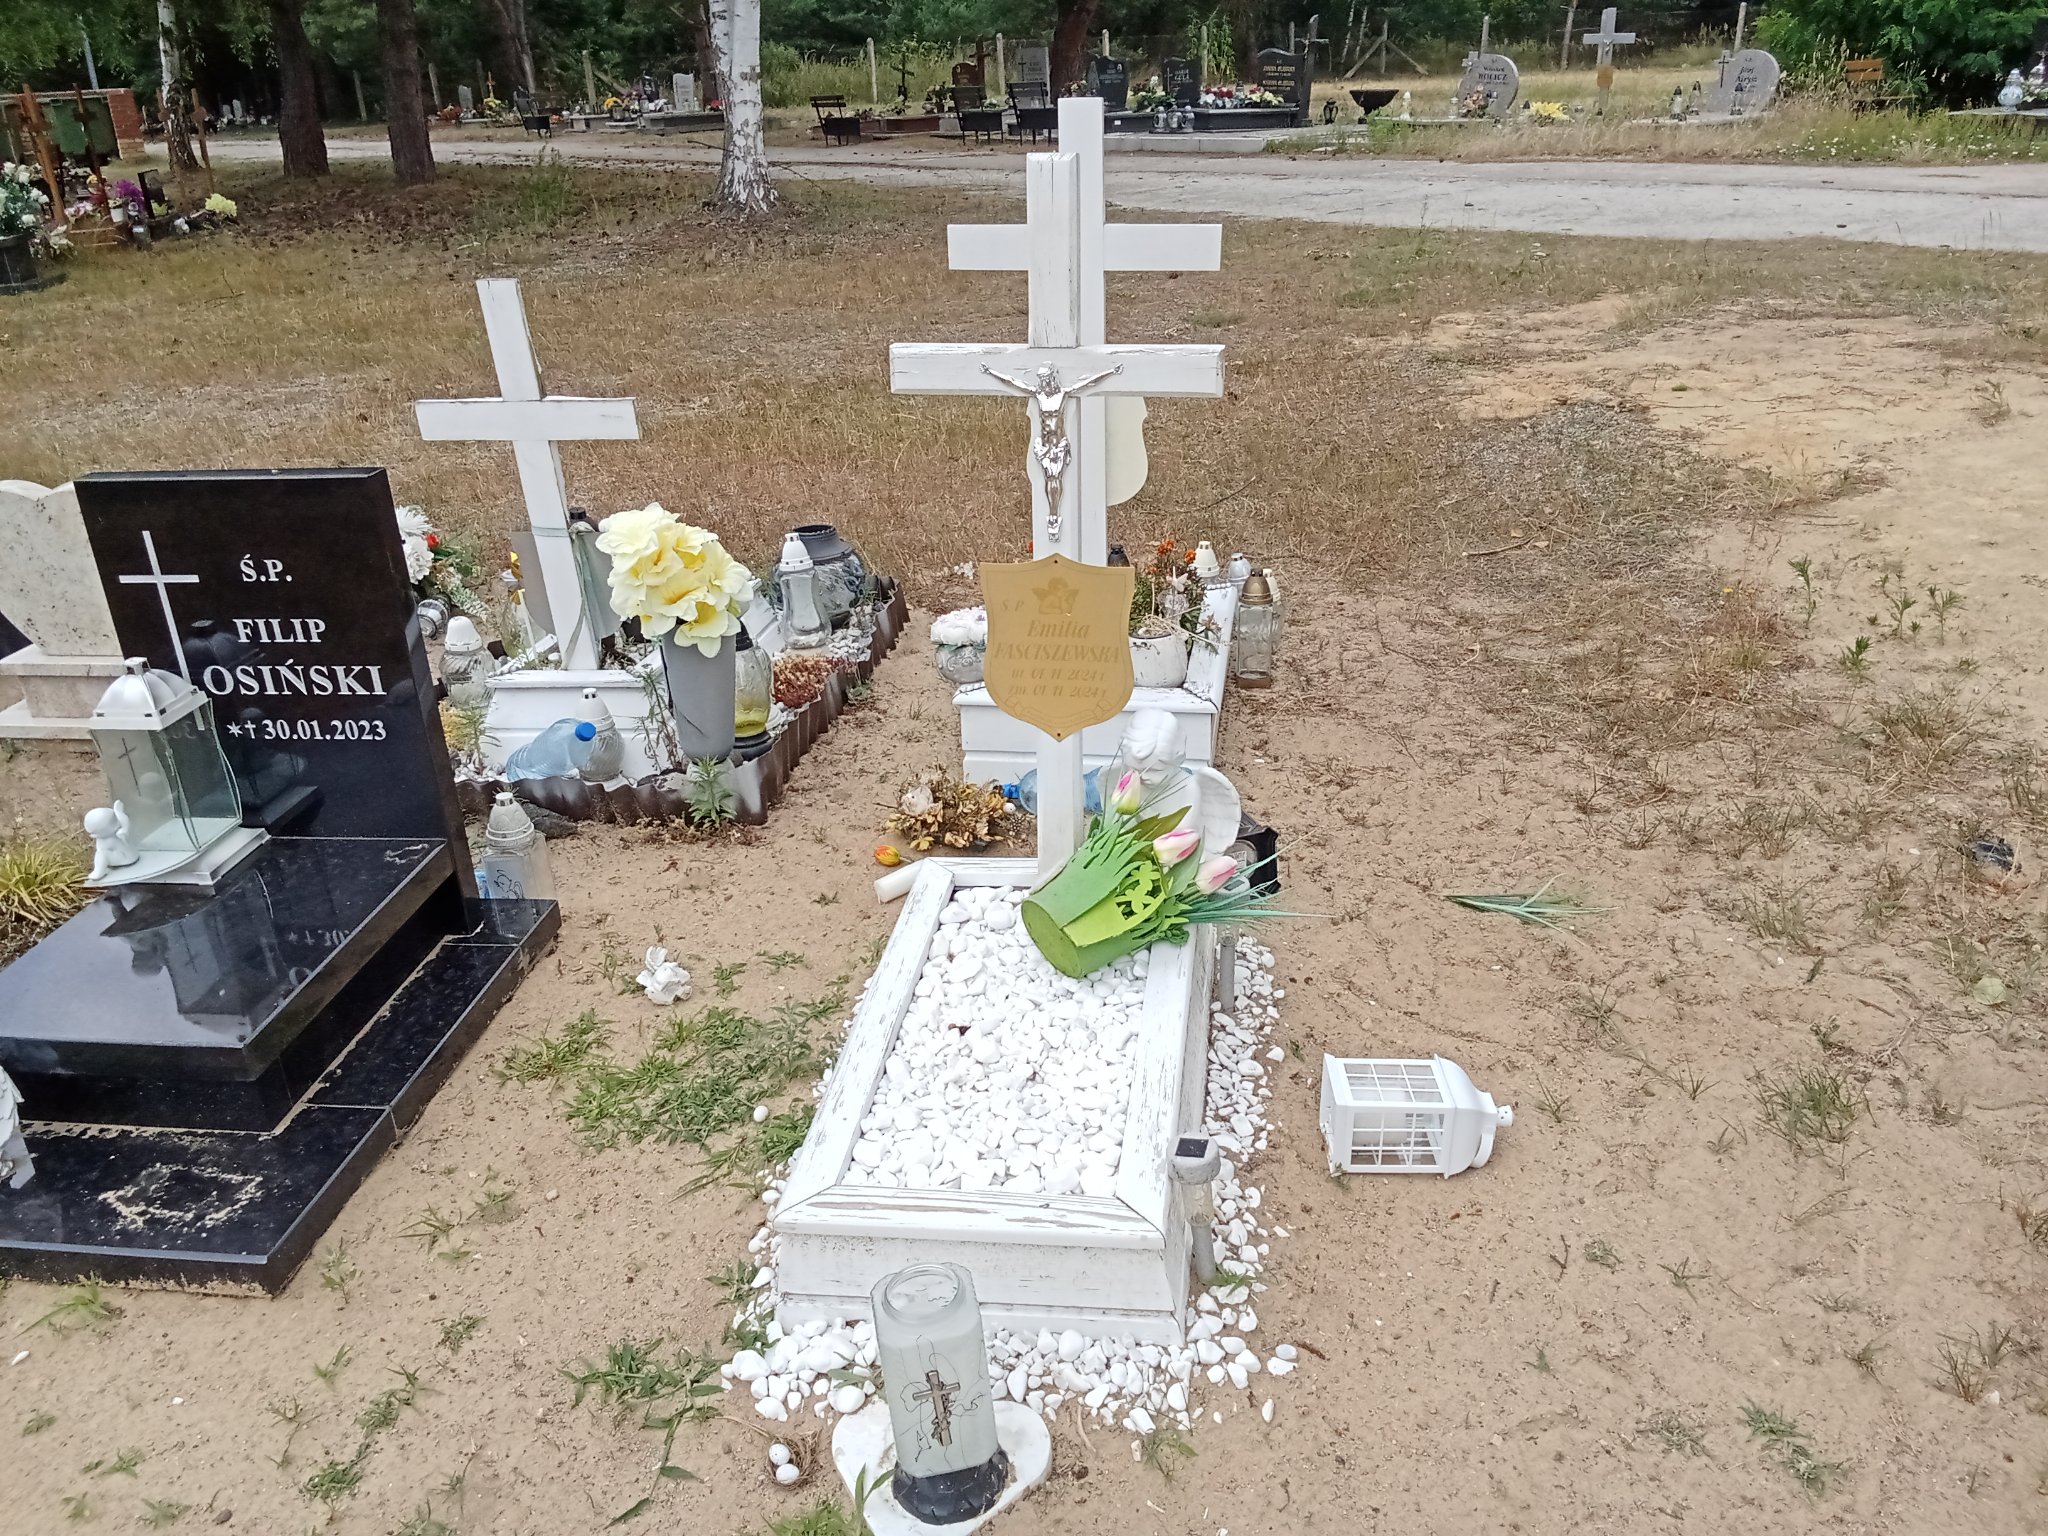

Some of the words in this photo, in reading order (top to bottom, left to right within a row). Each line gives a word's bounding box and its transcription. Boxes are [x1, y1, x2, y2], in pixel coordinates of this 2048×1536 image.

[239, 553, 293, 582] Ś.P.
[232, 618, 326, 643] FILIP
[1027, 619, 1091, 639] Emilia
[203, 658, 388, 696] OSIŃSKI
